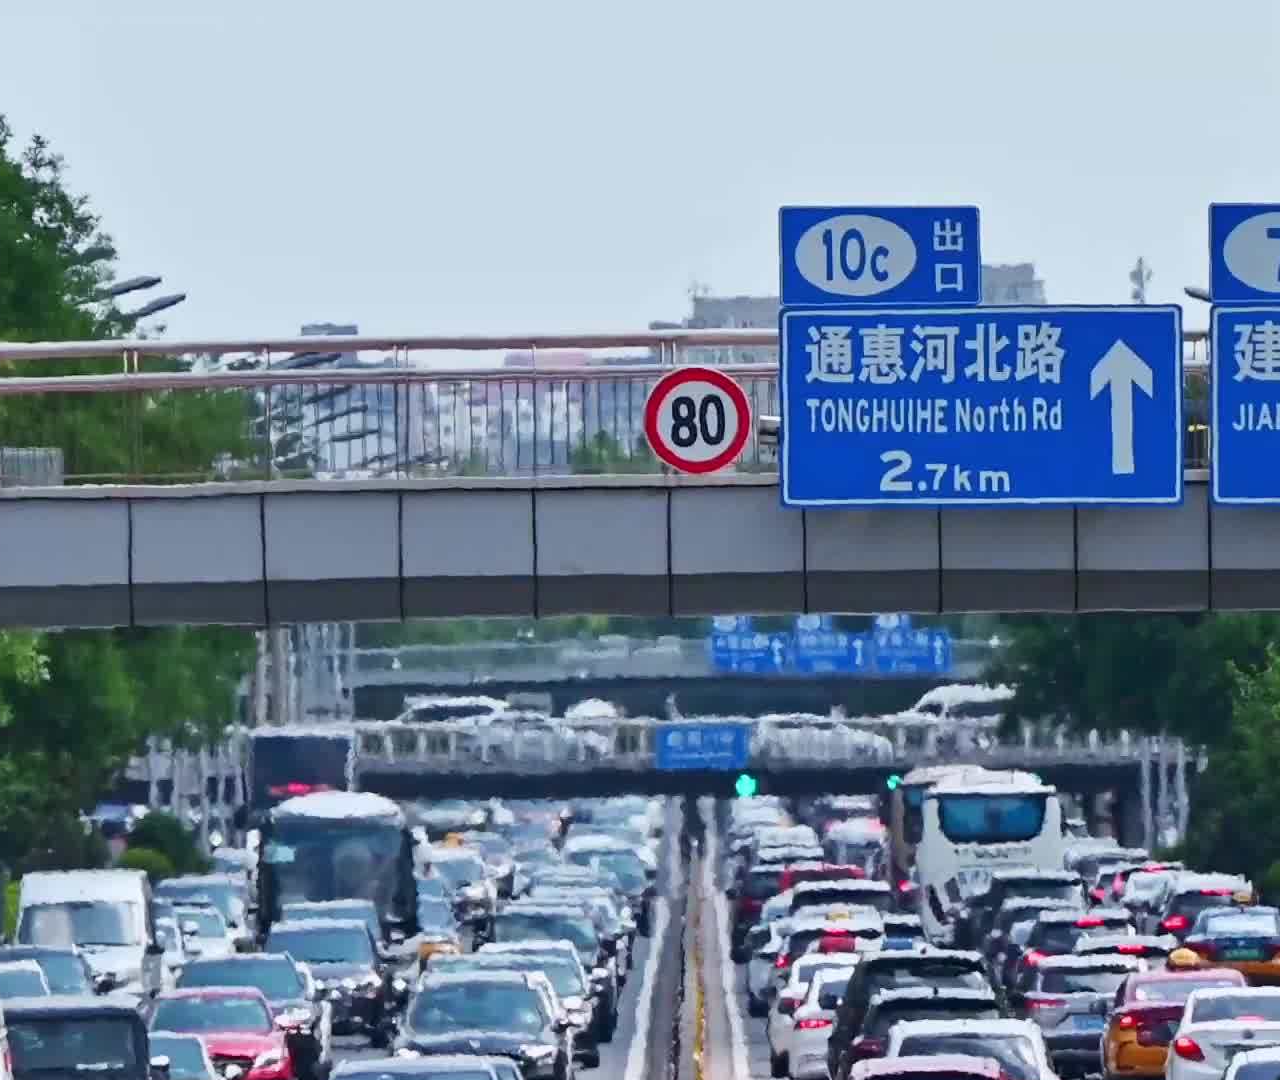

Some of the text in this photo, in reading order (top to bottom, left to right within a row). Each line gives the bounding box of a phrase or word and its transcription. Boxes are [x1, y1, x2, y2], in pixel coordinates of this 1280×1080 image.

[932, 218, 964, 293] 出口
[805, 321, 1065, 385] 通惠河北路
[670, 394, 726, 450] 80
[806, 397, 1063, 433] TONGHUIHE North Rd
[878, 449, 1012, 494] 2.7km
